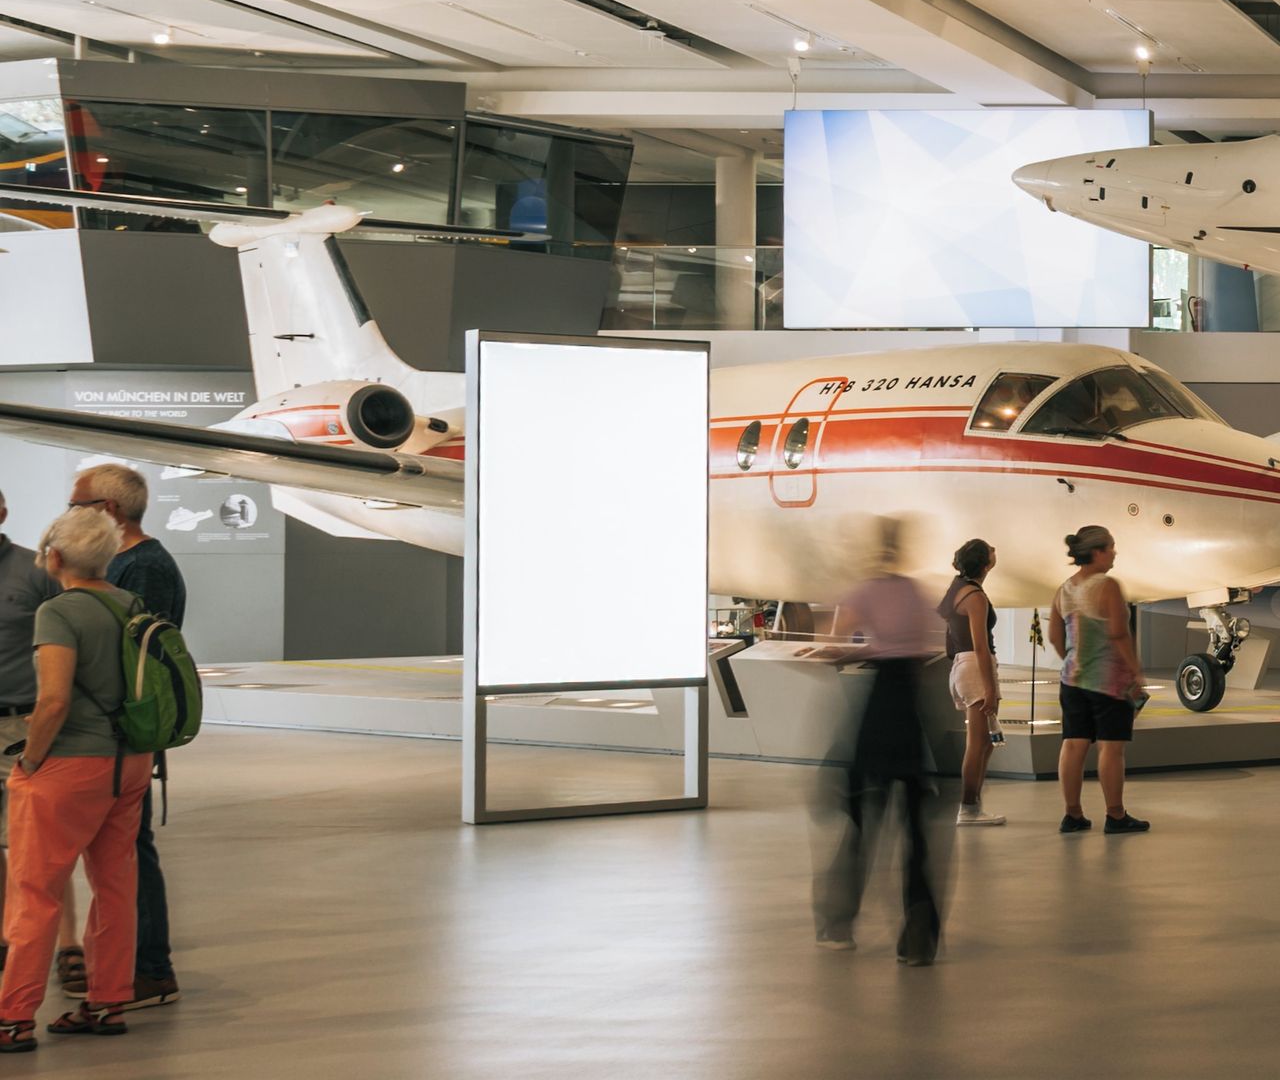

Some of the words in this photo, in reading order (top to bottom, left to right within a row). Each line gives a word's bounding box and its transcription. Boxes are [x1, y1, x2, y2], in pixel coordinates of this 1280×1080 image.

[862, 378, 899, 392] 320
[905, 375, 977, 389] HANSA
[75, 392, 103, 402] VON
[107, 390, 171, 402] MÜNCHEN
[174, 392, 188, 402] IN
[191, 392, 210, 402] DIE
[214, 392, 245, 402] WELT
